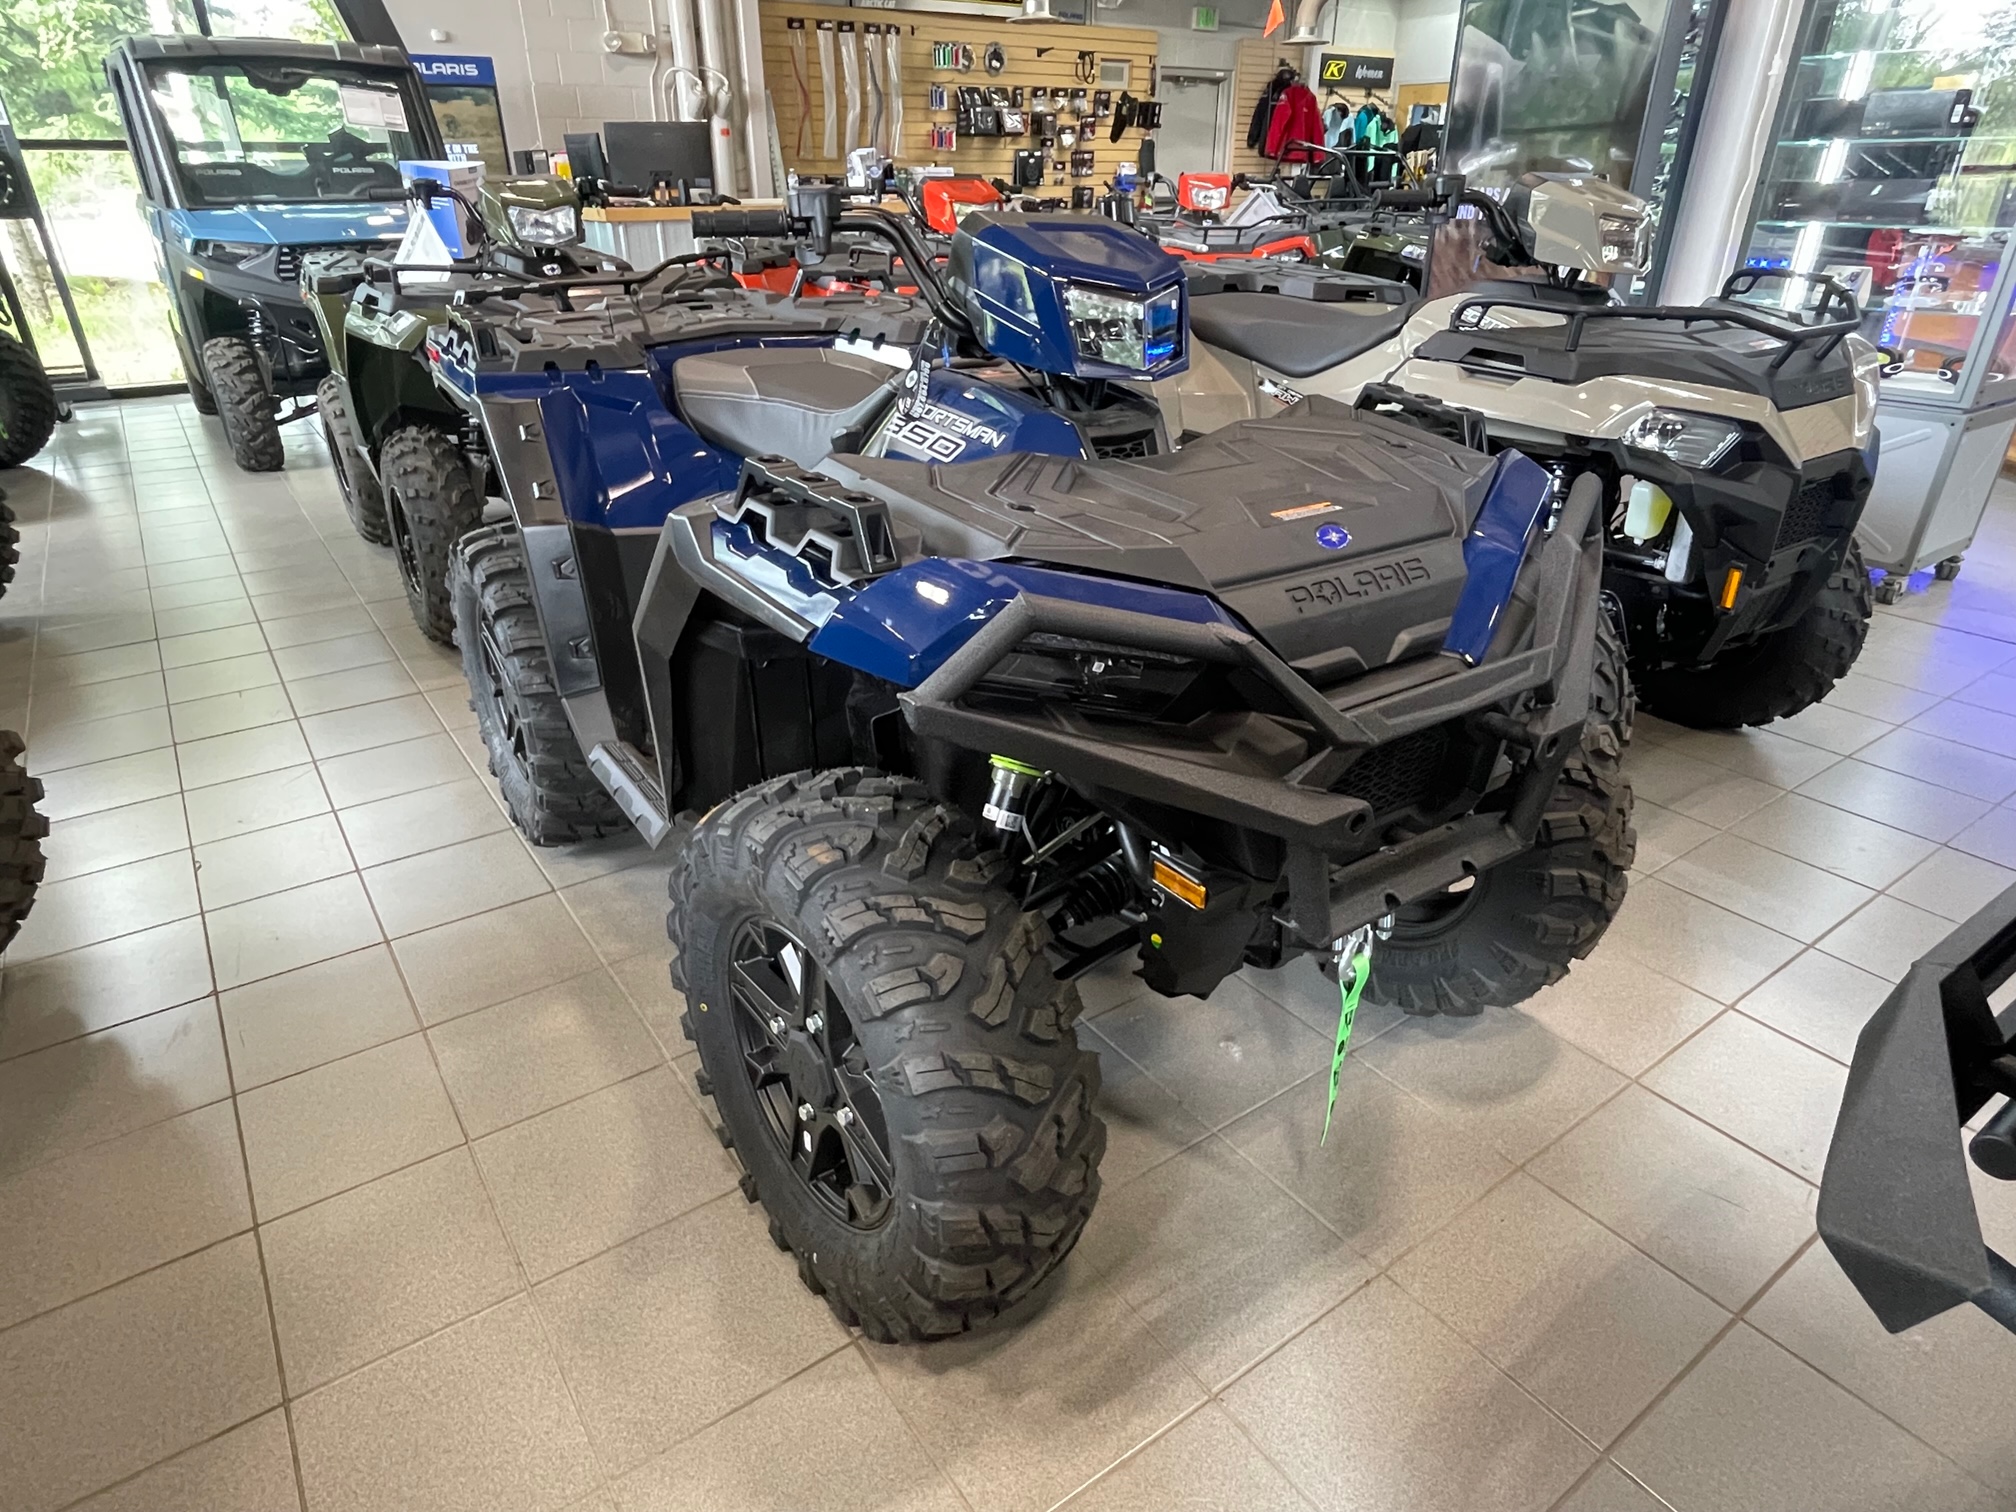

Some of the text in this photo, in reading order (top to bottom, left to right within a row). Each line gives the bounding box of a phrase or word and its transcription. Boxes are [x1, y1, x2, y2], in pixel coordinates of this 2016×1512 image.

[413, 62, 479, 76] LARIS
[1355, 64, 1383, 79] Women
[462, 144, 479, 154] THE
[195, 168, 242, 176] POLARIS
[921, 403, 1006, 448] ORTSMAN
[1285, 557, 1431, 614] POLARIS
